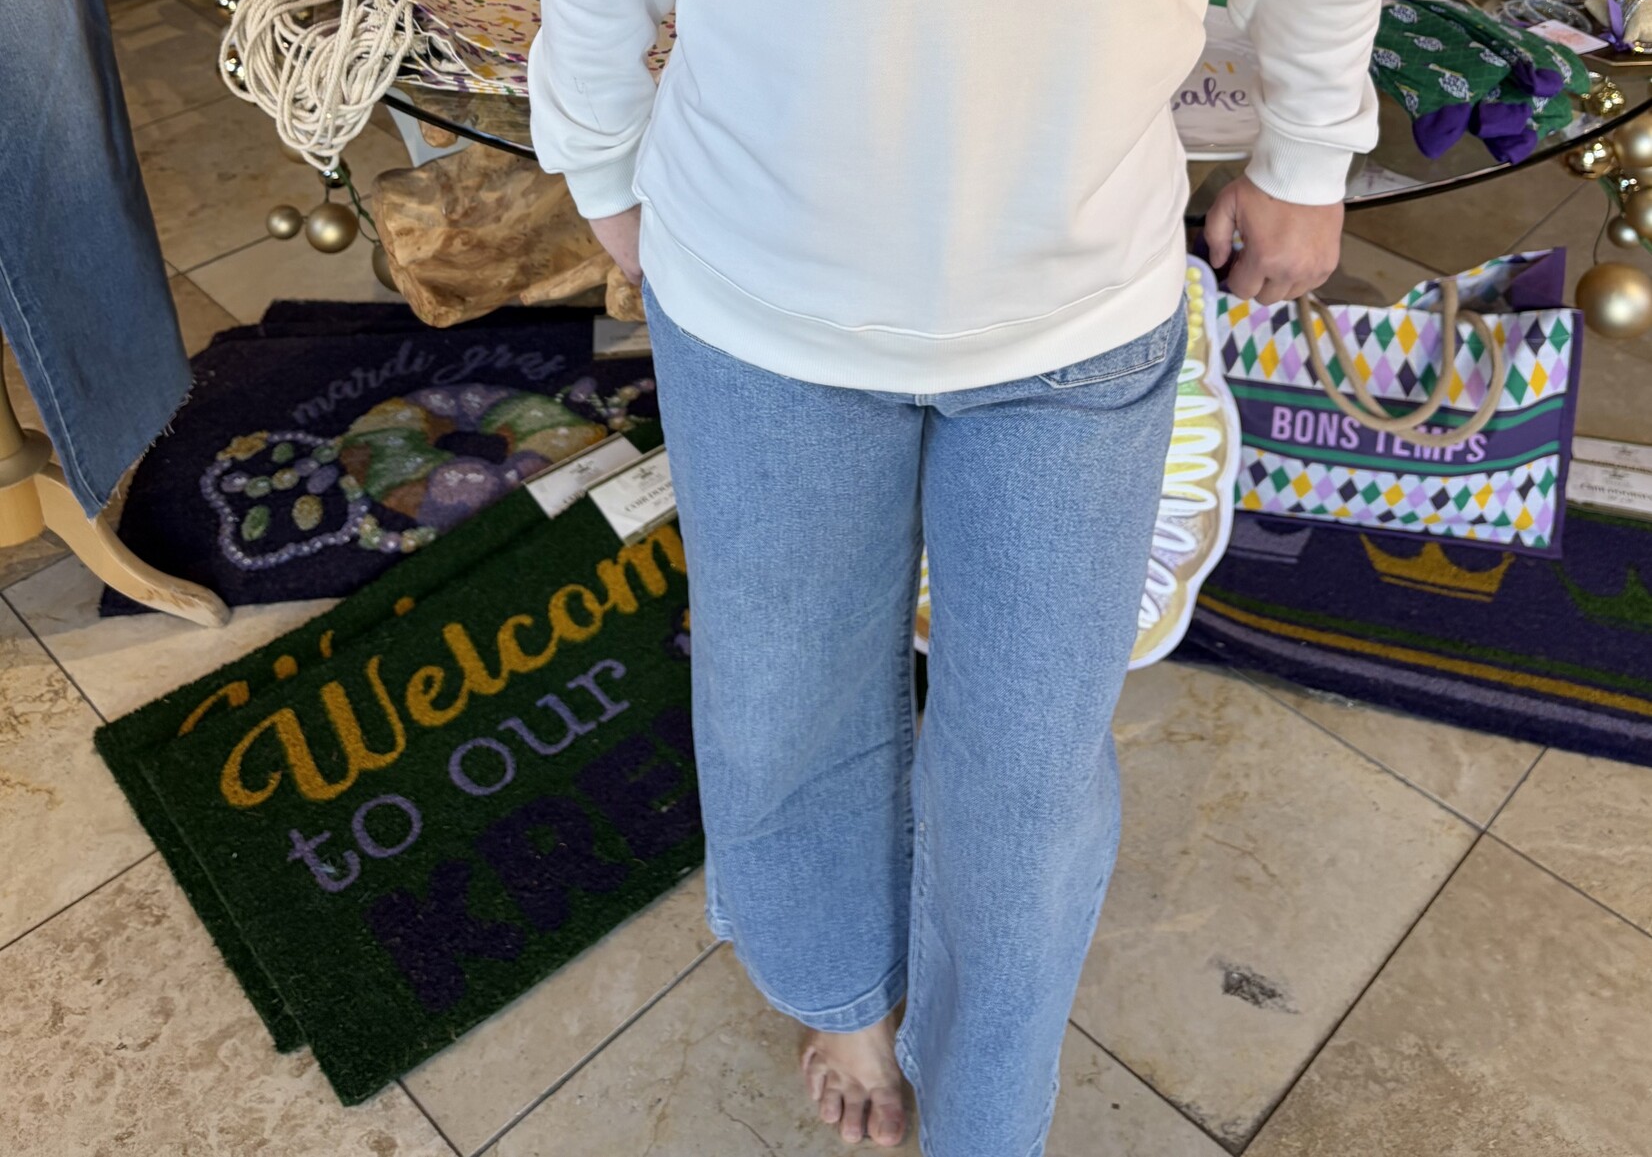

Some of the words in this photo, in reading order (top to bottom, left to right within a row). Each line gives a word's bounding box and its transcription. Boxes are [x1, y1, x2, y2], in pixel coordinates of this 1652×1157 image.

[293, 341, 436, 424] mardi
[431, 344, 566, 385] gras
[1270, 405, 1362, 450] BONS
[219, 524, 689, 809] Welcom
[288, 794, 423, 894] to
[448, 657, 632, 797] our
[364, 706, 702, 1013] KRE
